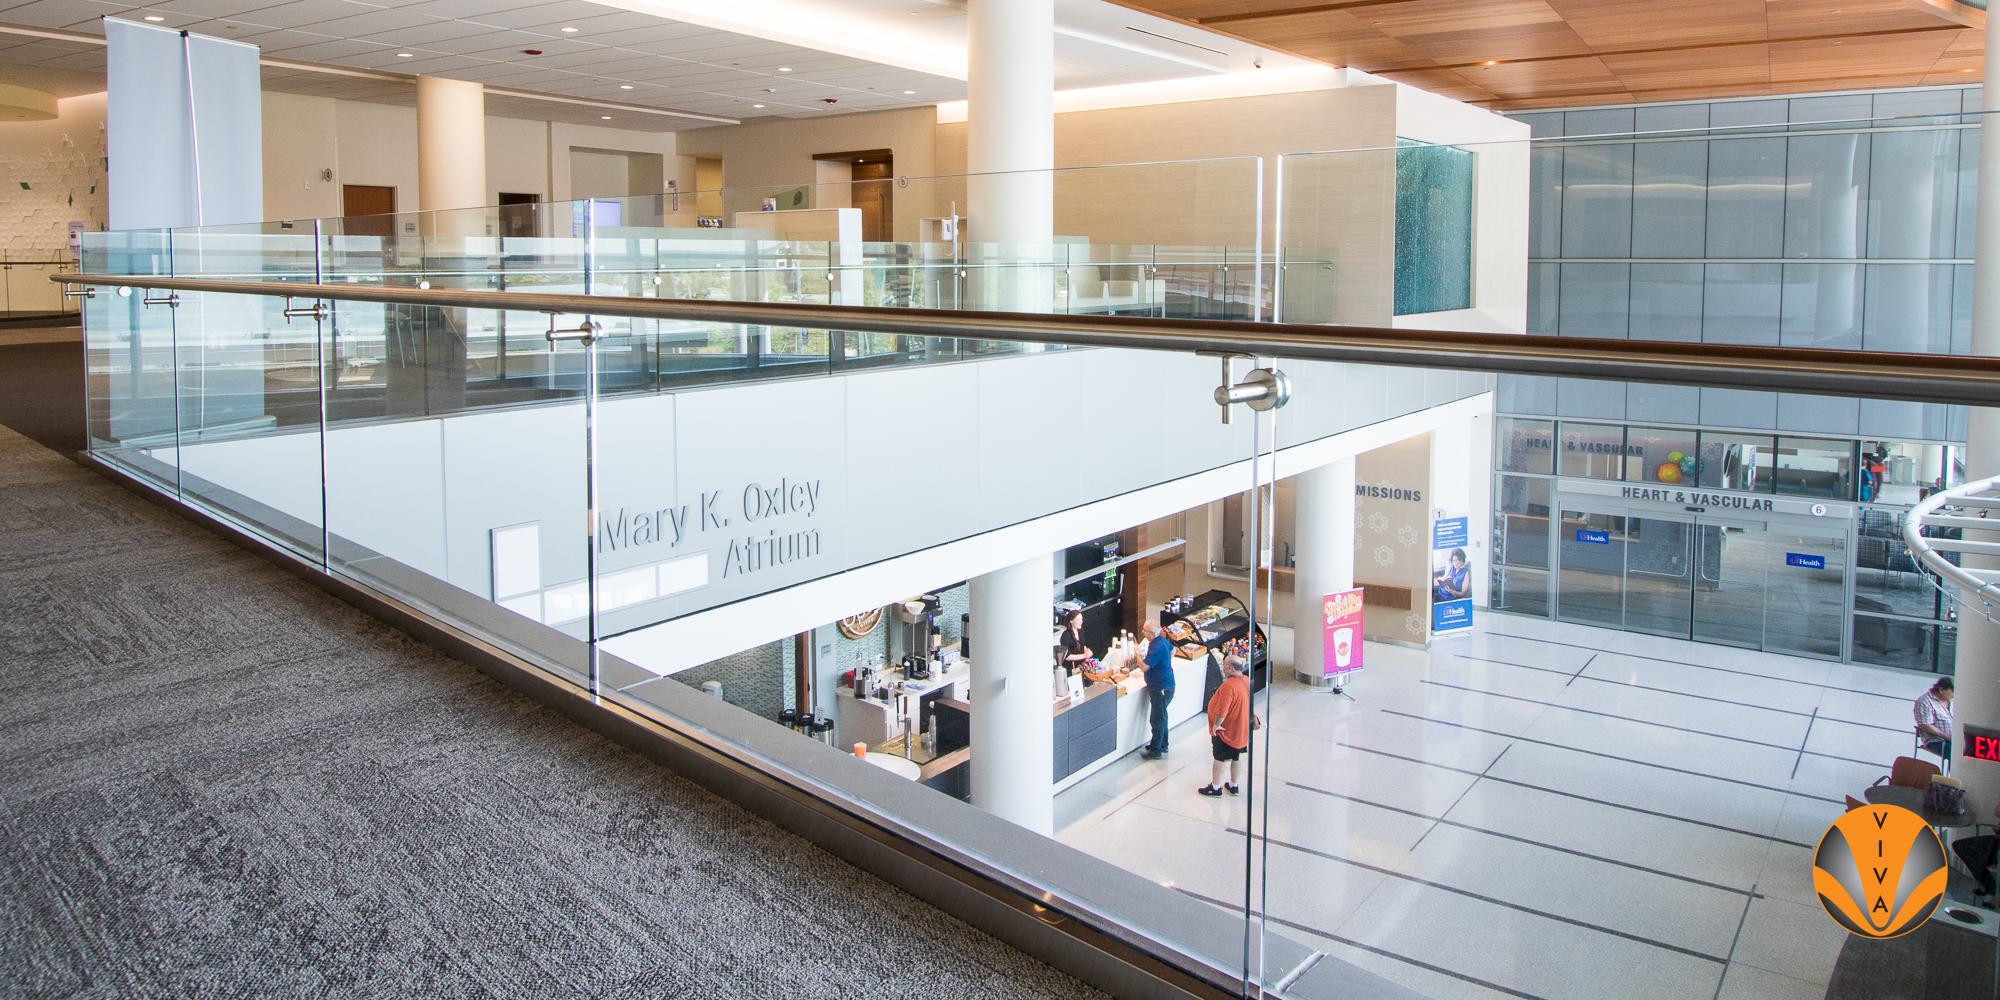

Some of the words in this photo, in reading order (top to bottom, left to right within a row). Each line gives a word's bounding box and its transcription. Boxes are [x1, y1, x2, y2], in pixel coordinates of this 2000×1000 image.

[1526, 438, 1563, 450] HEA
[1567, 441, 1575, 451] &
[1622, 487, 1670, 502] HEART
[1675, 491, 1686, 503] &
[1691, 493, 1773, 512] VASCULAR
[1816, 506, 1823, 514] 6
[597, 505, 688, 554] Mary
[701, 489, 730, 532] K.
[743, 477, 820, 522] Oxley
[723, 528, 820, 579] Atrium
